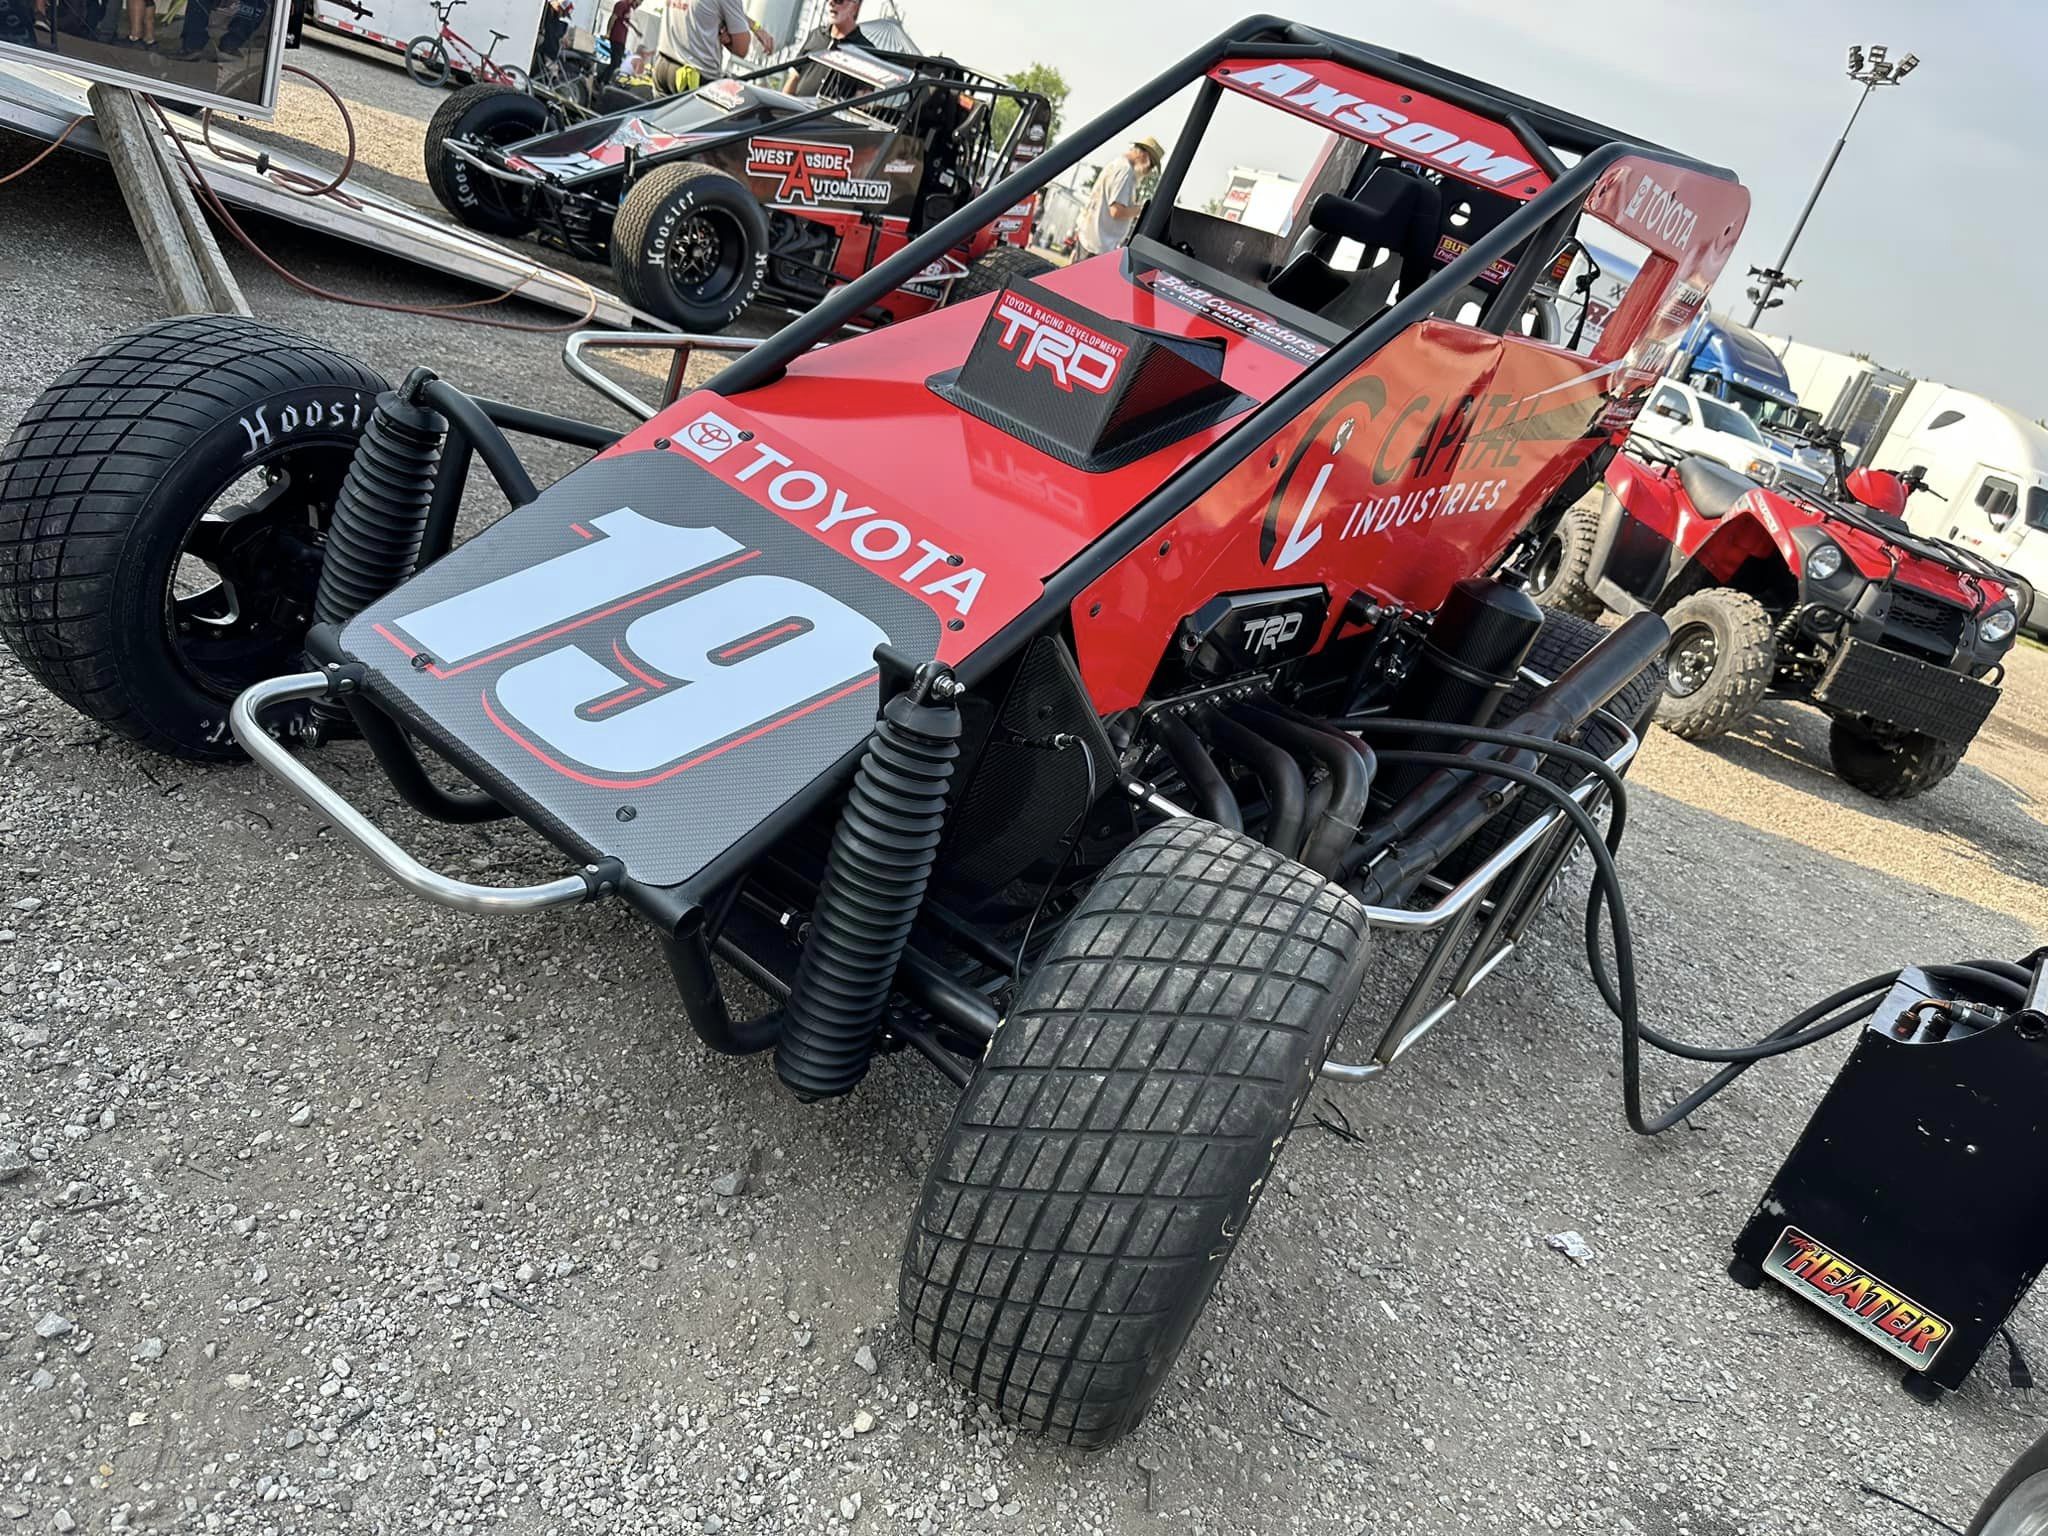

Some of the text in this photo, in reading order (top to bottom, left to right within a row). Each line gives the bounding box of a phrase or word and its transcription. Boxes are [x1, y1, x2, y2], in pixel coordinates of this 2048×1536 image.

[1229, 63, 1534, 182] AXSOM
[754, 149, 844, 170] WEST SIDE
[780, 150, 888, 199] AUTOMATION
[1639, 183, 1698, 250] TOYOTA
[1004, 294, 1123, 358] TOYOTA RACING DEVELOPMENT
[1177, 295, 1210, 313] Where
[998, 303, 1117, 389] TRD
[239, 391, 375, 461] Hoosi
[1372, 393, 1544, 486] CAPITAL
[735, 443, 987, 615] TOYOTA
[1339, 479, 1508, 541] INDUSTRIES
[393, 506, 892, 773] 19
[1243, 612, 1303, 654] TRD
[1784, 1248, 1946, 1354] HEATER
